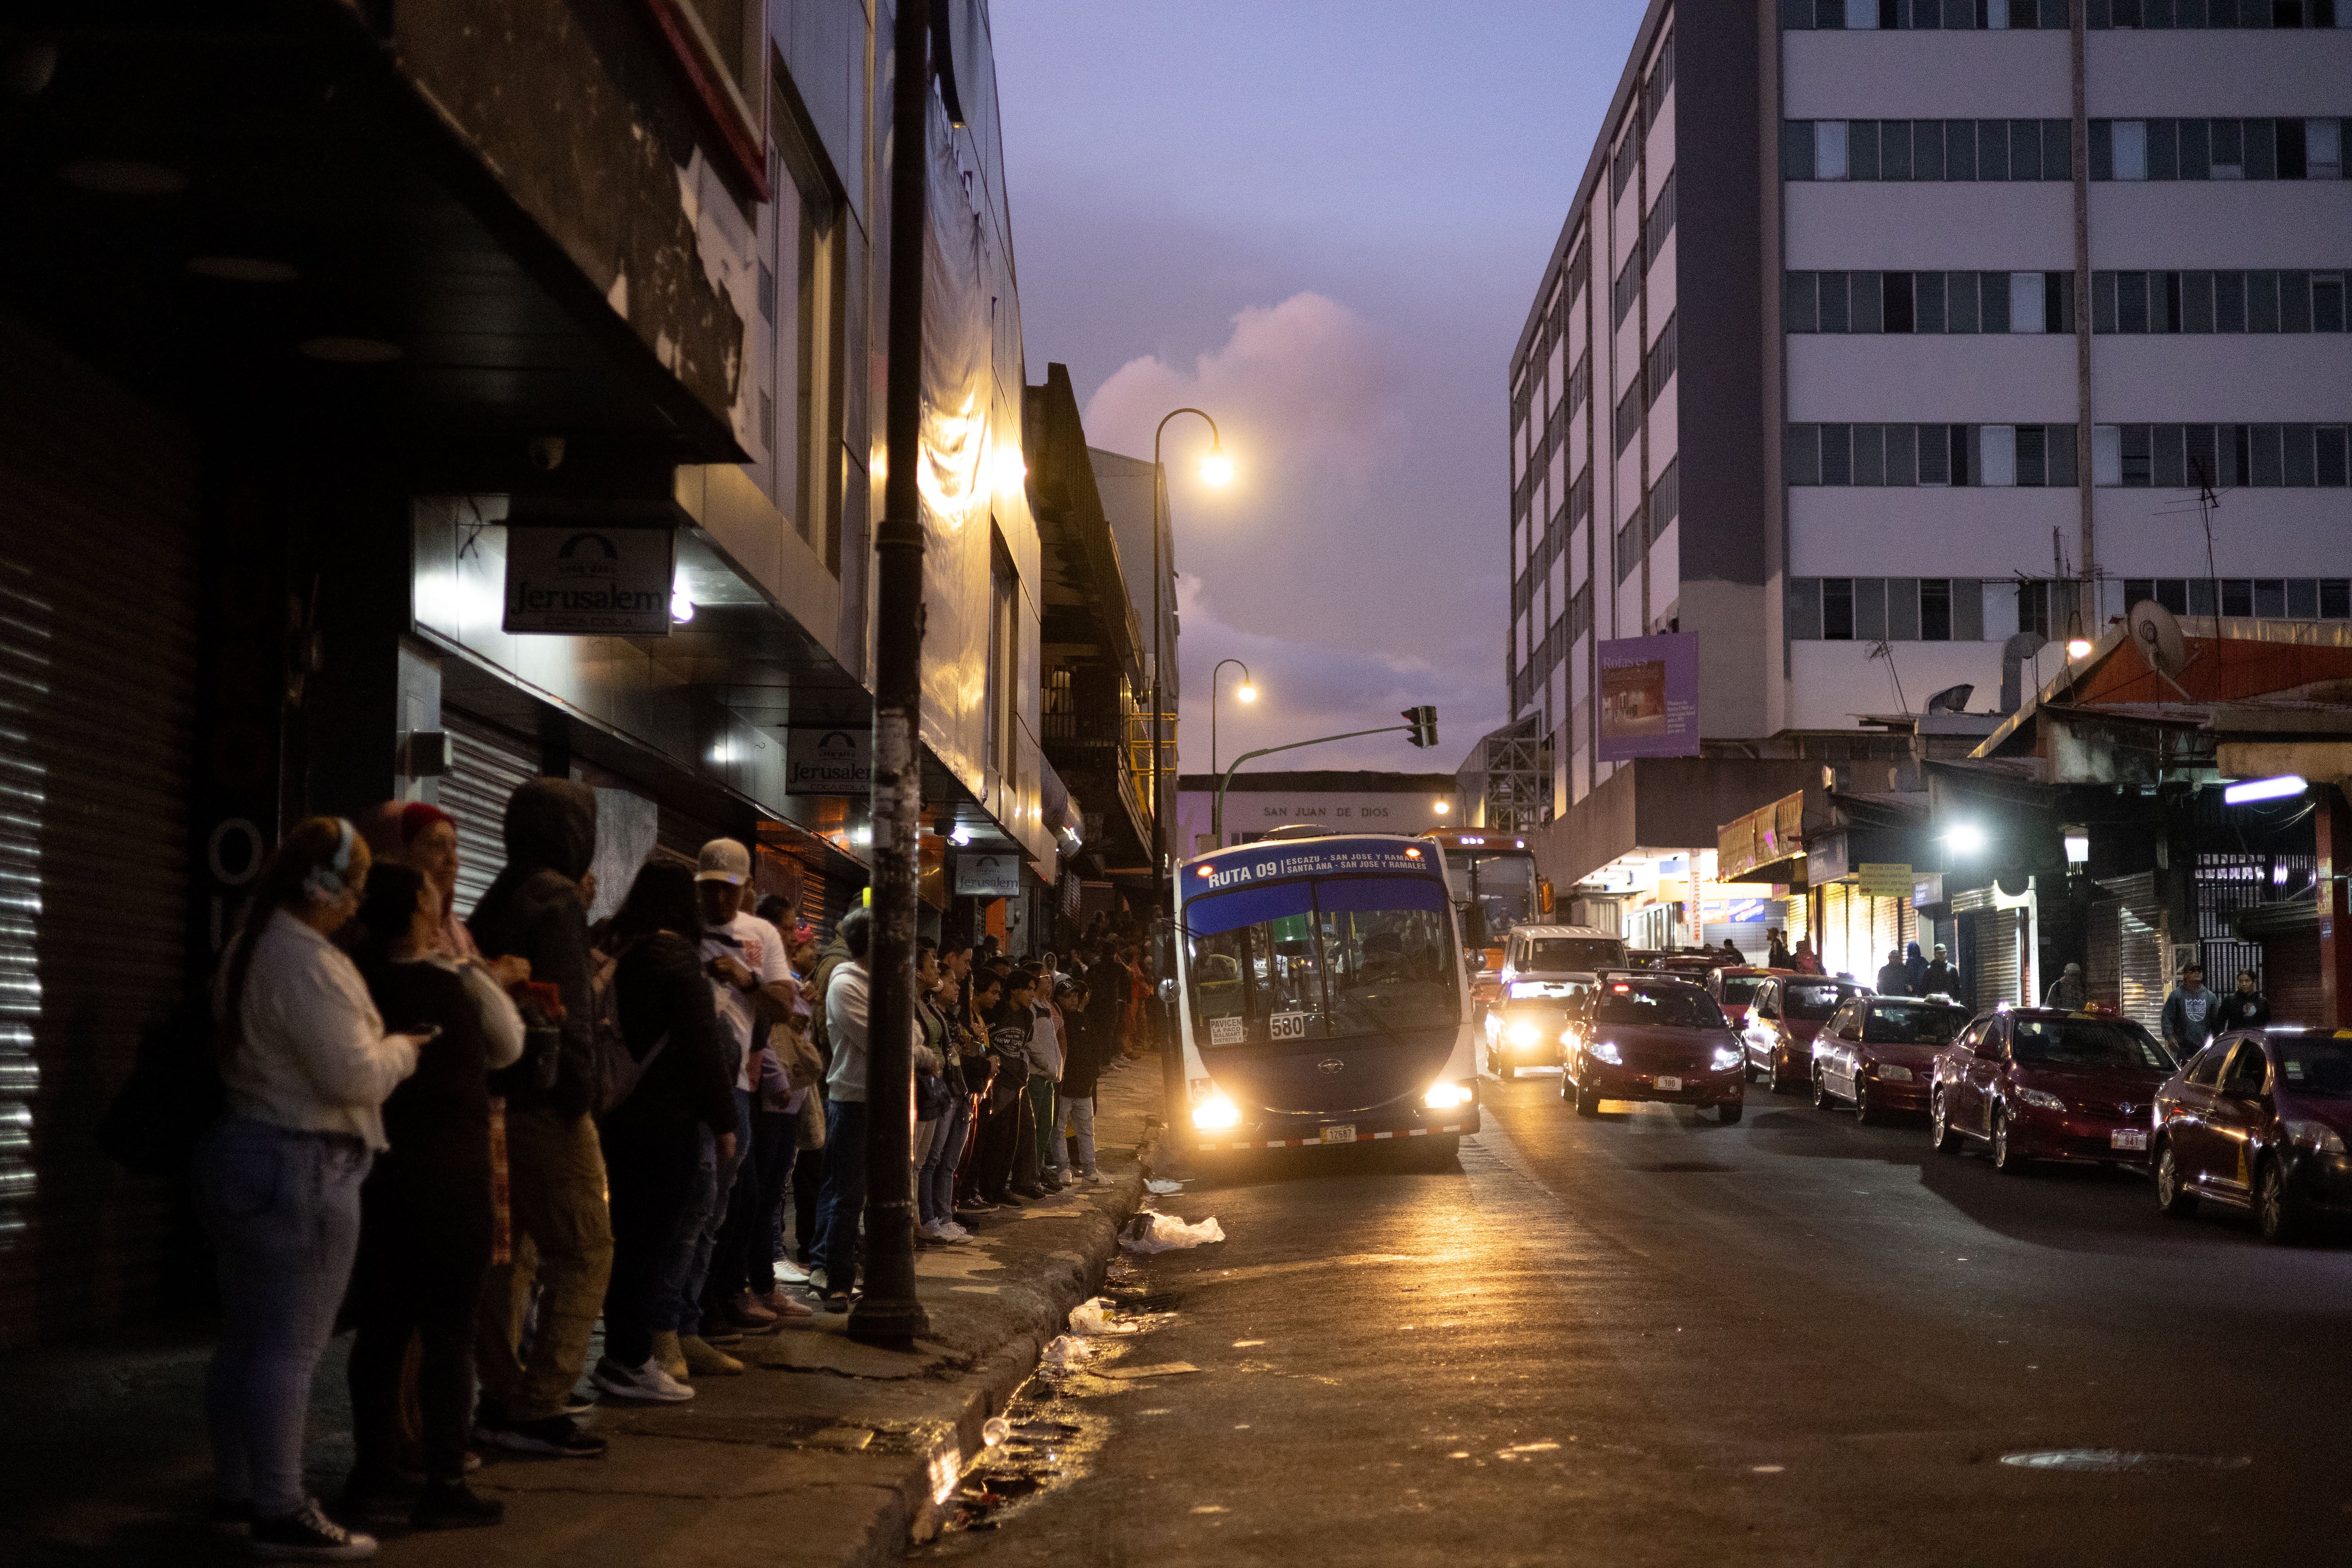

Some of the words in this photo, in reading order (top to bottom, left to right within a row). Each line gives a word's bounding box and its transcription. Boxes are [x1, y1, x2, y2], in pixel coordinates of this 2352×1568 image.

[511, 581, 663, 614] Jerusalem
[1264, 807, 1287, 816] SAN
[1295, 807, 1326, 816] JUAN
[1337, 808, 1351, 817] DE
[1361, 808, 1389, 817] DIOS
[1287, 856, 1319, 866] ESCAZU
[1287, 864, 1313, 874] SANTA
[1389, 861, 1427, 870] RAMALES
[1208, 867, 1252, 889] RUTA
[1256, 862, 1277, 878] 09
[957, 876, 1018, 890] Jerusalem
[1211, 1019, 1241, 1028] PAVICEN
[1271, 1016, 1303, 1037] 580
[1330, 1129, 1351, 1139] 12687
